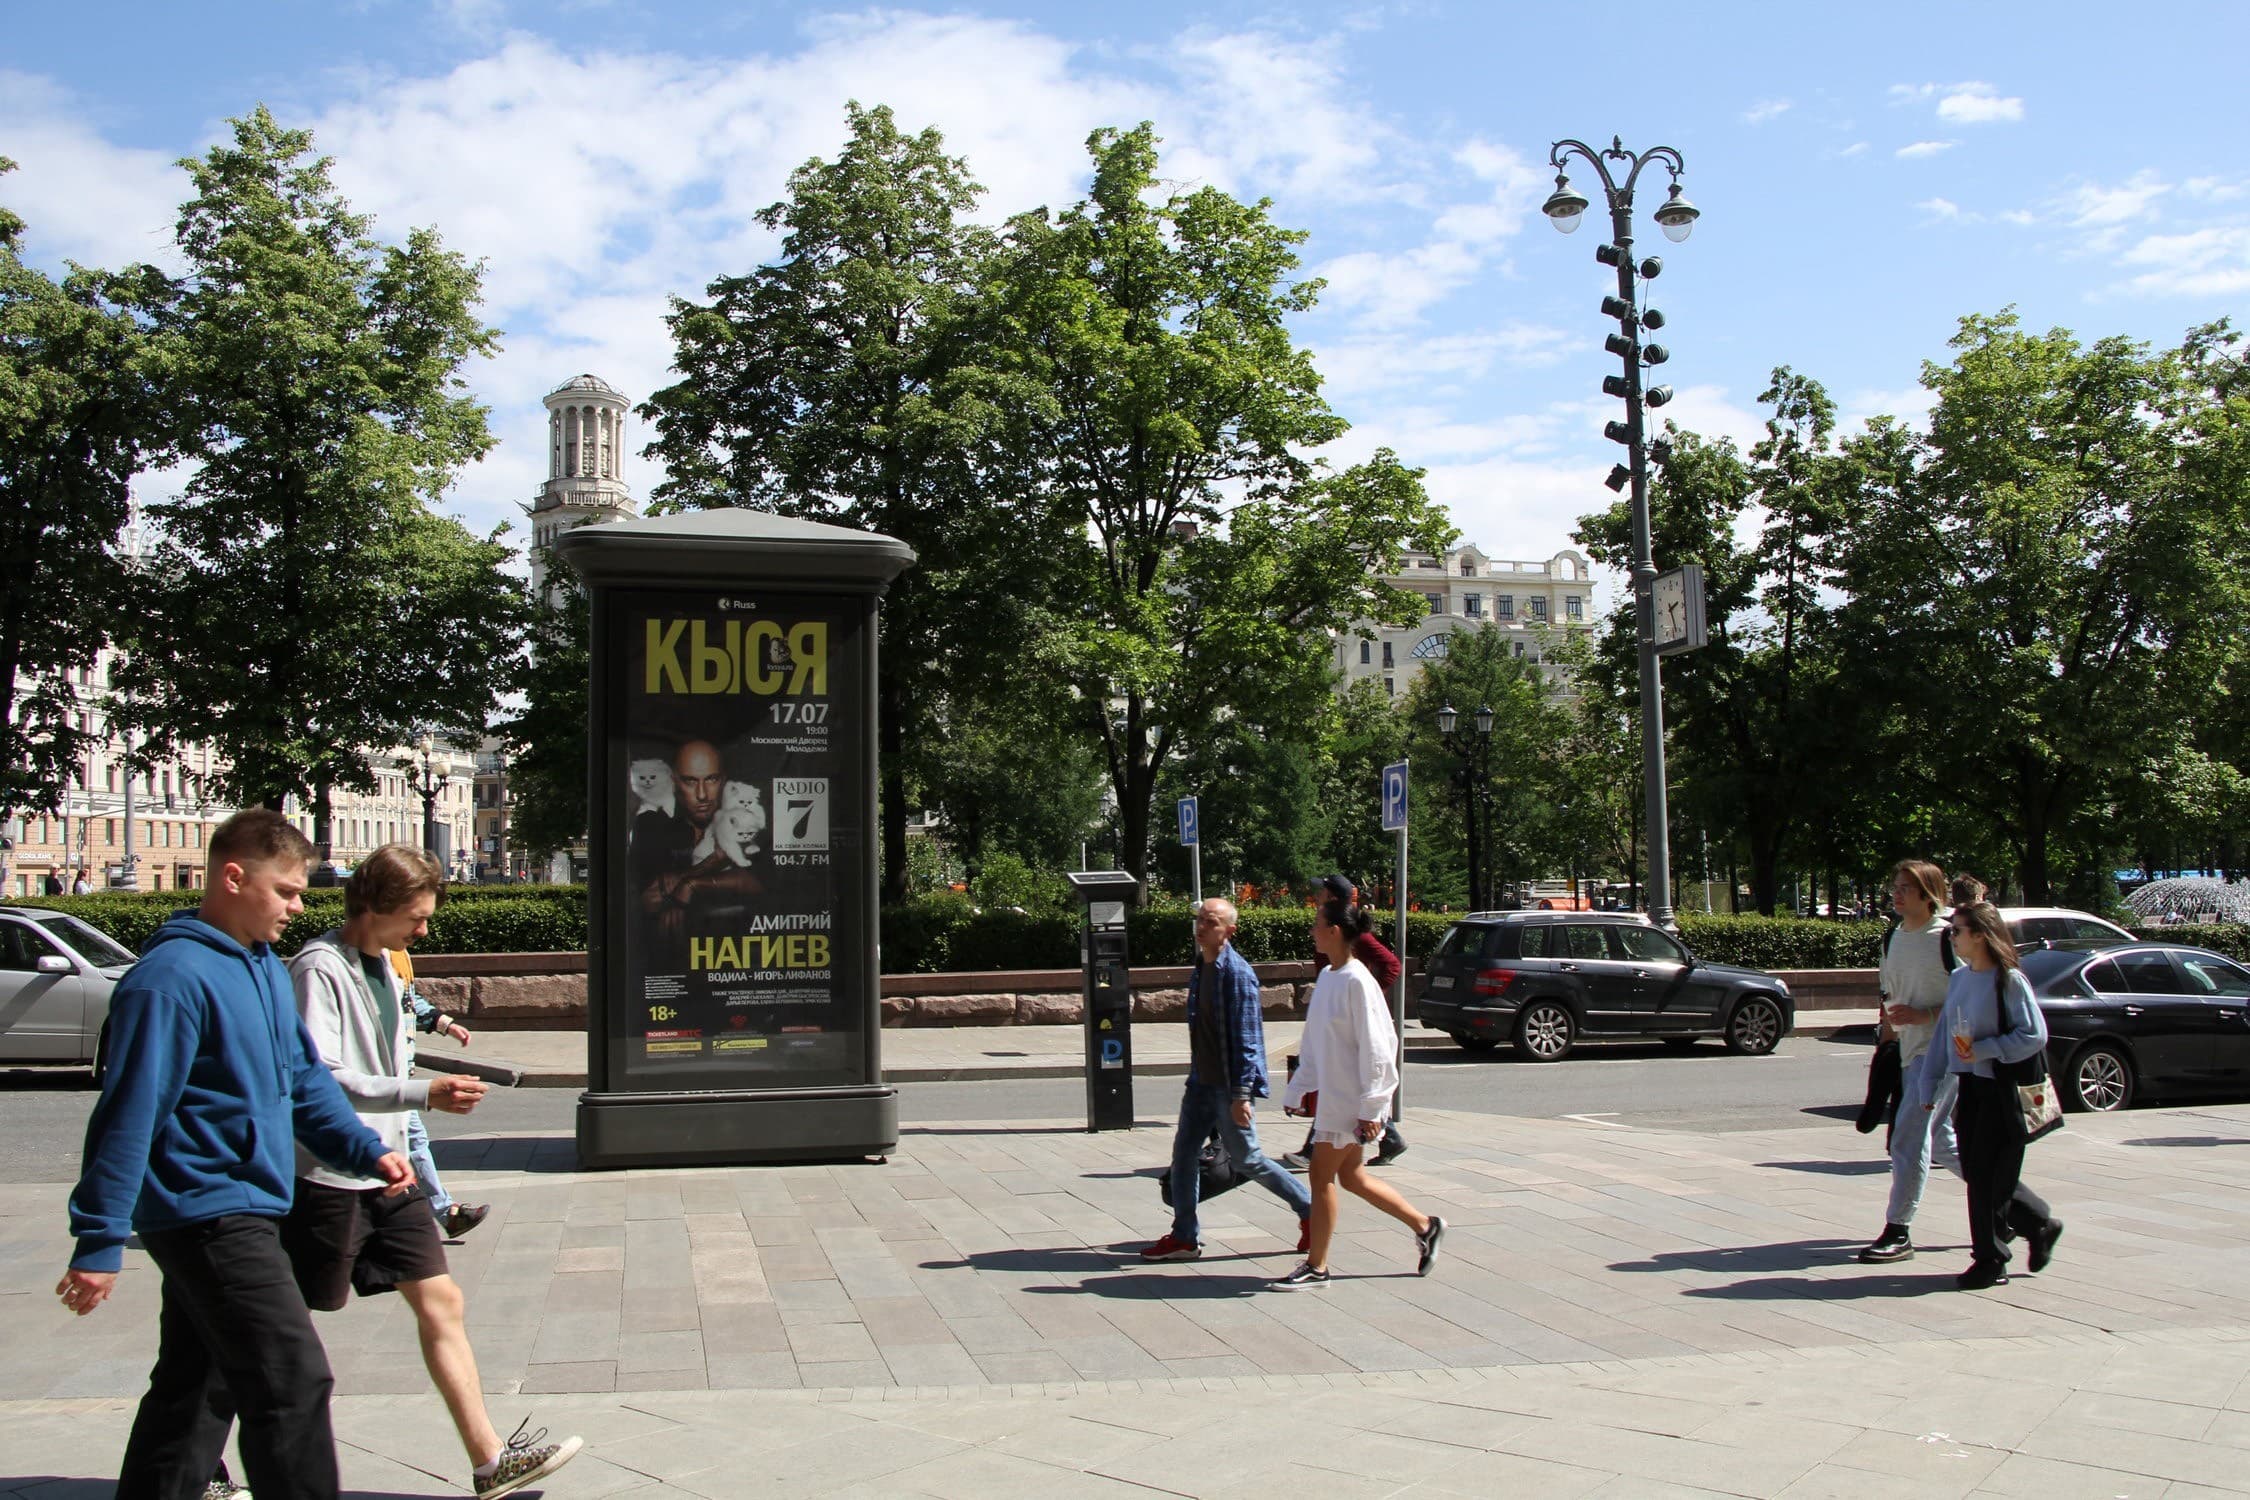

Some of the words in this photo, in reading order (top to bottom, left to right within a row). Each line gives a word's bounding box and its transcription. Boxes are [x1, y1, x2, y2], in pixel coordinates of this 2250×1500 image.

[733, 600, 756, 610] Russ
[645, 619, 828, 696] КЫСЯ
[769, 703, 829, 724] 17.07
[805, 726, 828, 735] 19:00
[776, 781, 826, 795] RADIO
[1390, 773, 1402, 822] P
[787, 800, 815, 840] 7
[1183, 804, 1194, 840] P
[773, 854, 807, 866] 104.7
[811, 854, 830, 865] FM
[750, 911, 831, 934] ДМИТРИЙ
[690, 935, 831, 970] НАГИЕВ
[708, 972, 747, 983] ВОДИЛА
[754, 970, 784, 980] ИГОРЬ
[785, 970, 831, 980] ЛИФАНОВ
[649, 1005, 677, 1021] 18+
